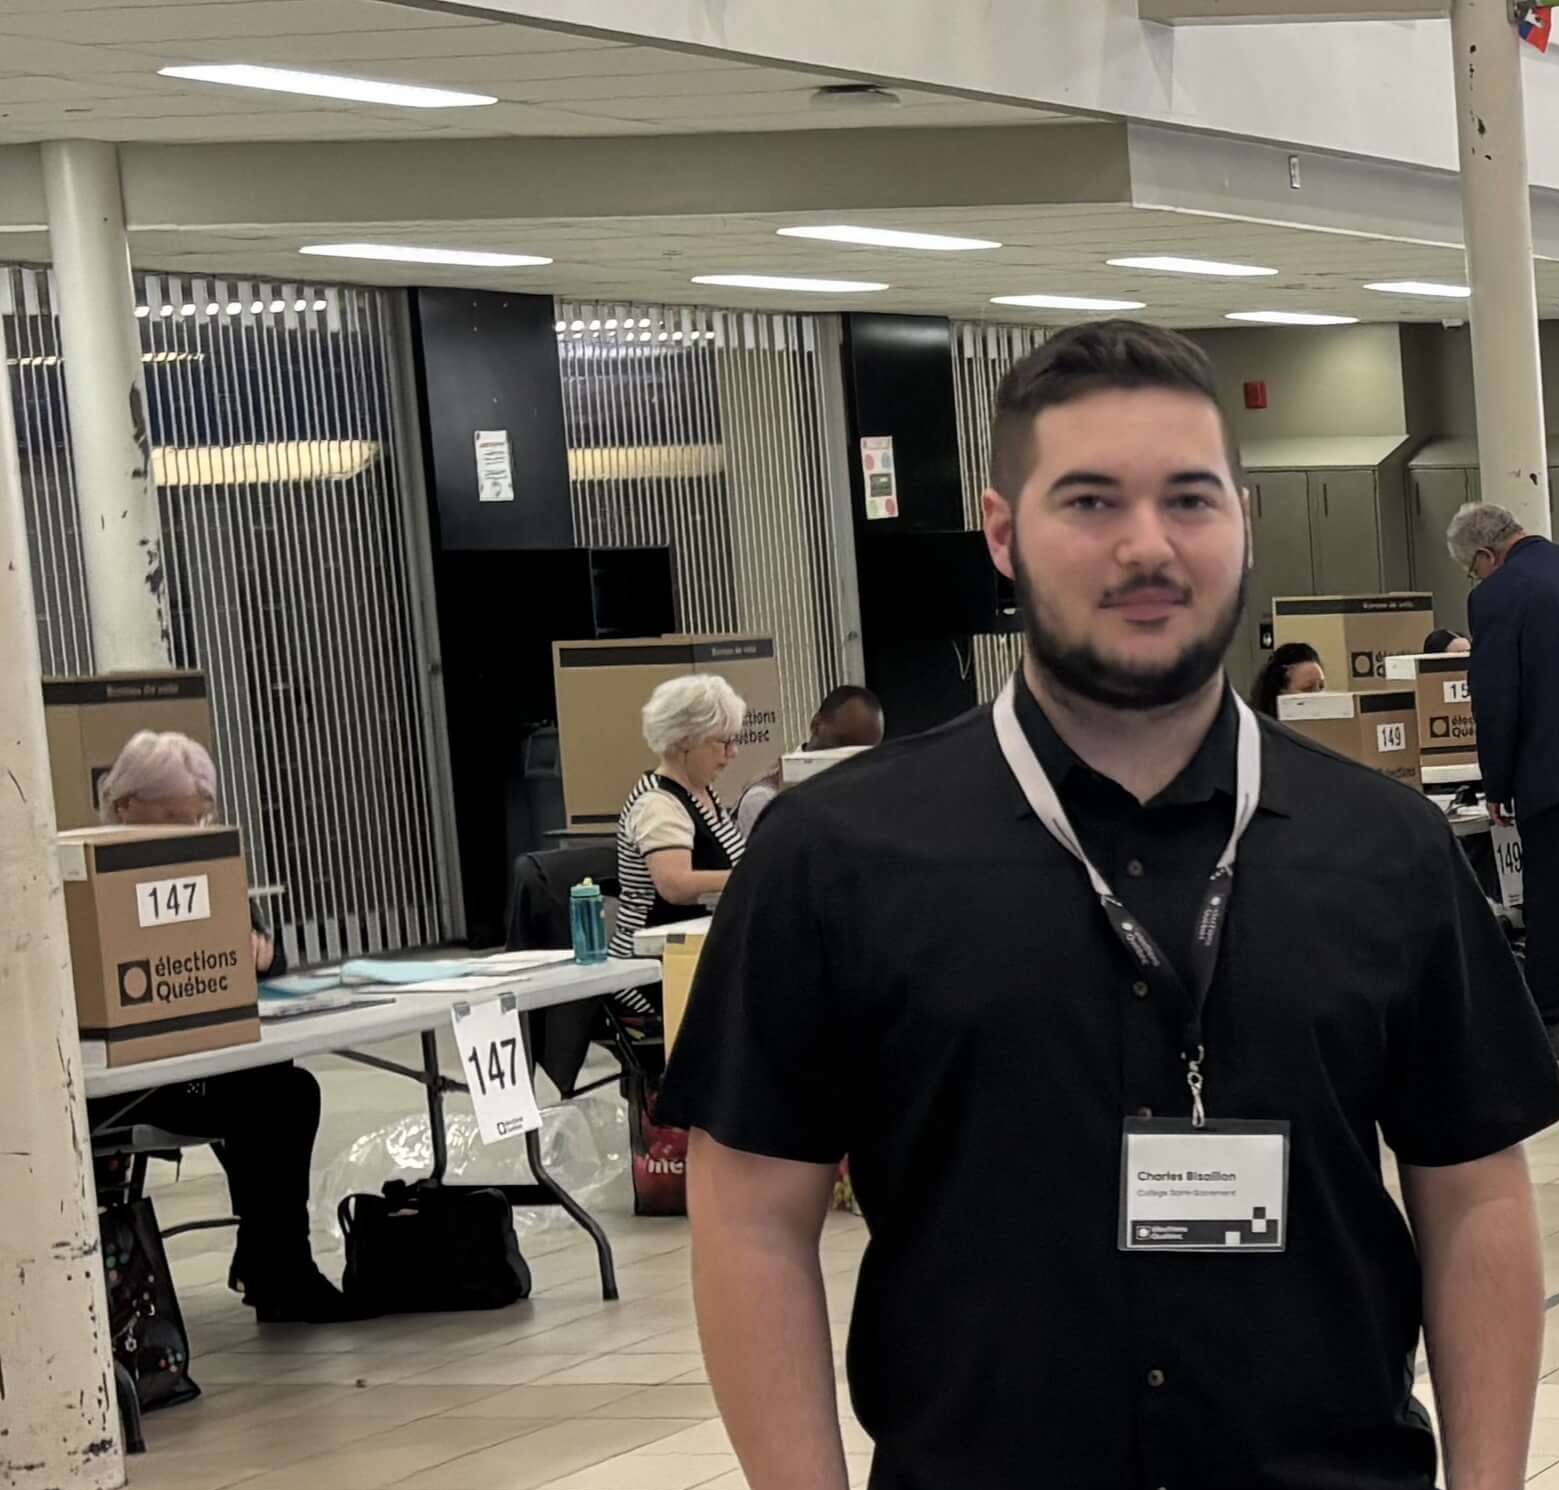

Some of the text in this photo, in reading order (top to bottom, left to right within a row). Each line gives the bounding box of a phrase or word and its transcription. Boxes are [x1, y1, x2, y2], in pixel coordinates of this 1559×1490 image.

[1451, 683, 1469, 699] 15
[1382, 726, 1401, 747] 149
[1497, 841, 1522, 874] 149
[148, 881, 197, 920] 147
[155, 949, 238, 978] élections
[156, 975, 229, 1004] Québec
[468, 1037, 517, 1096] 147
[1137, 1171, 1183, 1181] Charles
